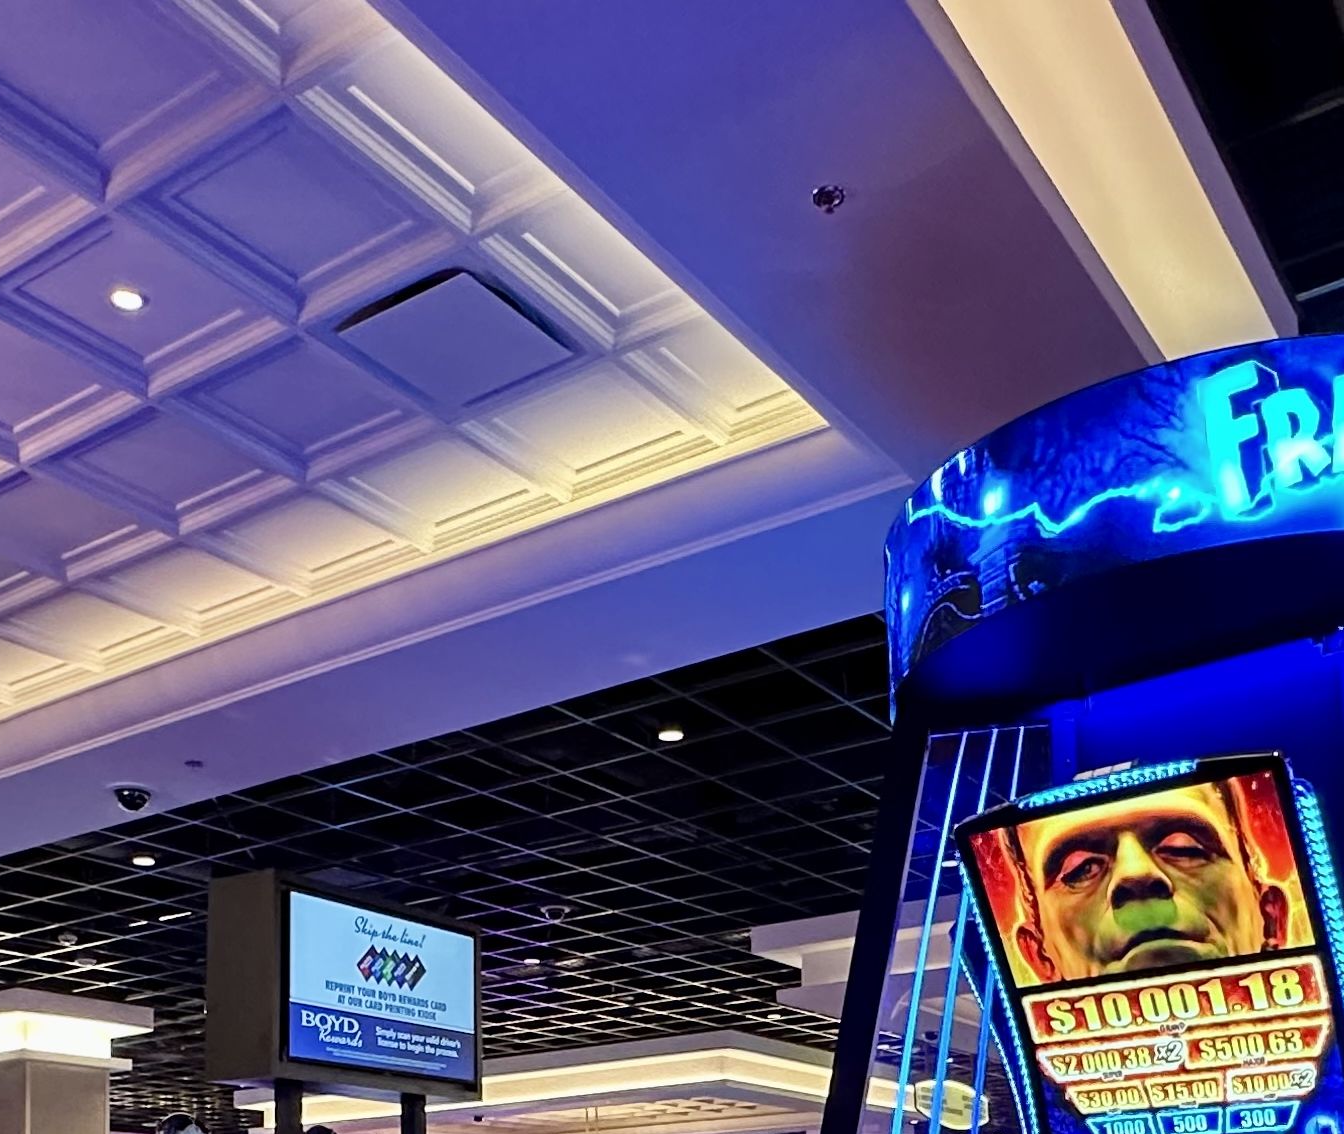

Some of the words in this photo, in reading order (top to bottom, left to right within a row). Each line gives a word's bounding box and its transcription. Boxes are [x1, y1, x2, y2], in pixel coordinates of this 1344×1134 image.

[354, 916, 382, 942] Skip
[381, 924, 399, 943] the
[399, 928, 427, 949] line!
[325, 979, 355, 995] REPRINT
[357, 986, 376, 999] YOUR
[378, 990, 397, 1002] BOYD
[398, 994, 429, 1009] REWARDS
[430, 1000, 447, 1012] CARD
[337, 994, 346, 1005] AT
[347, 996, 363, 1008] OUR
[364, 999, 383, 1012] CARD
[384, 1003, 416, 1018] PRINTING
[1045, 967, 1305, 1035] $10,001.18
[300, 1009, 360, 1034] BOYD
[318, 1026, 363, 1048] Rewards
[1198, 1029, 1304, 1061] $500.63
[1051, 1046, 1152, 1076] $2,000.38
[1151, 1079, 1219, 1102] $15.00
[1232, 1072, 1289, 1094] $10.00
[1077, 1087, 1142, 1109] $30.00
[1172, 1113, 1208, 1133] 500
[1240, 1108, 1277, 1128] 300
